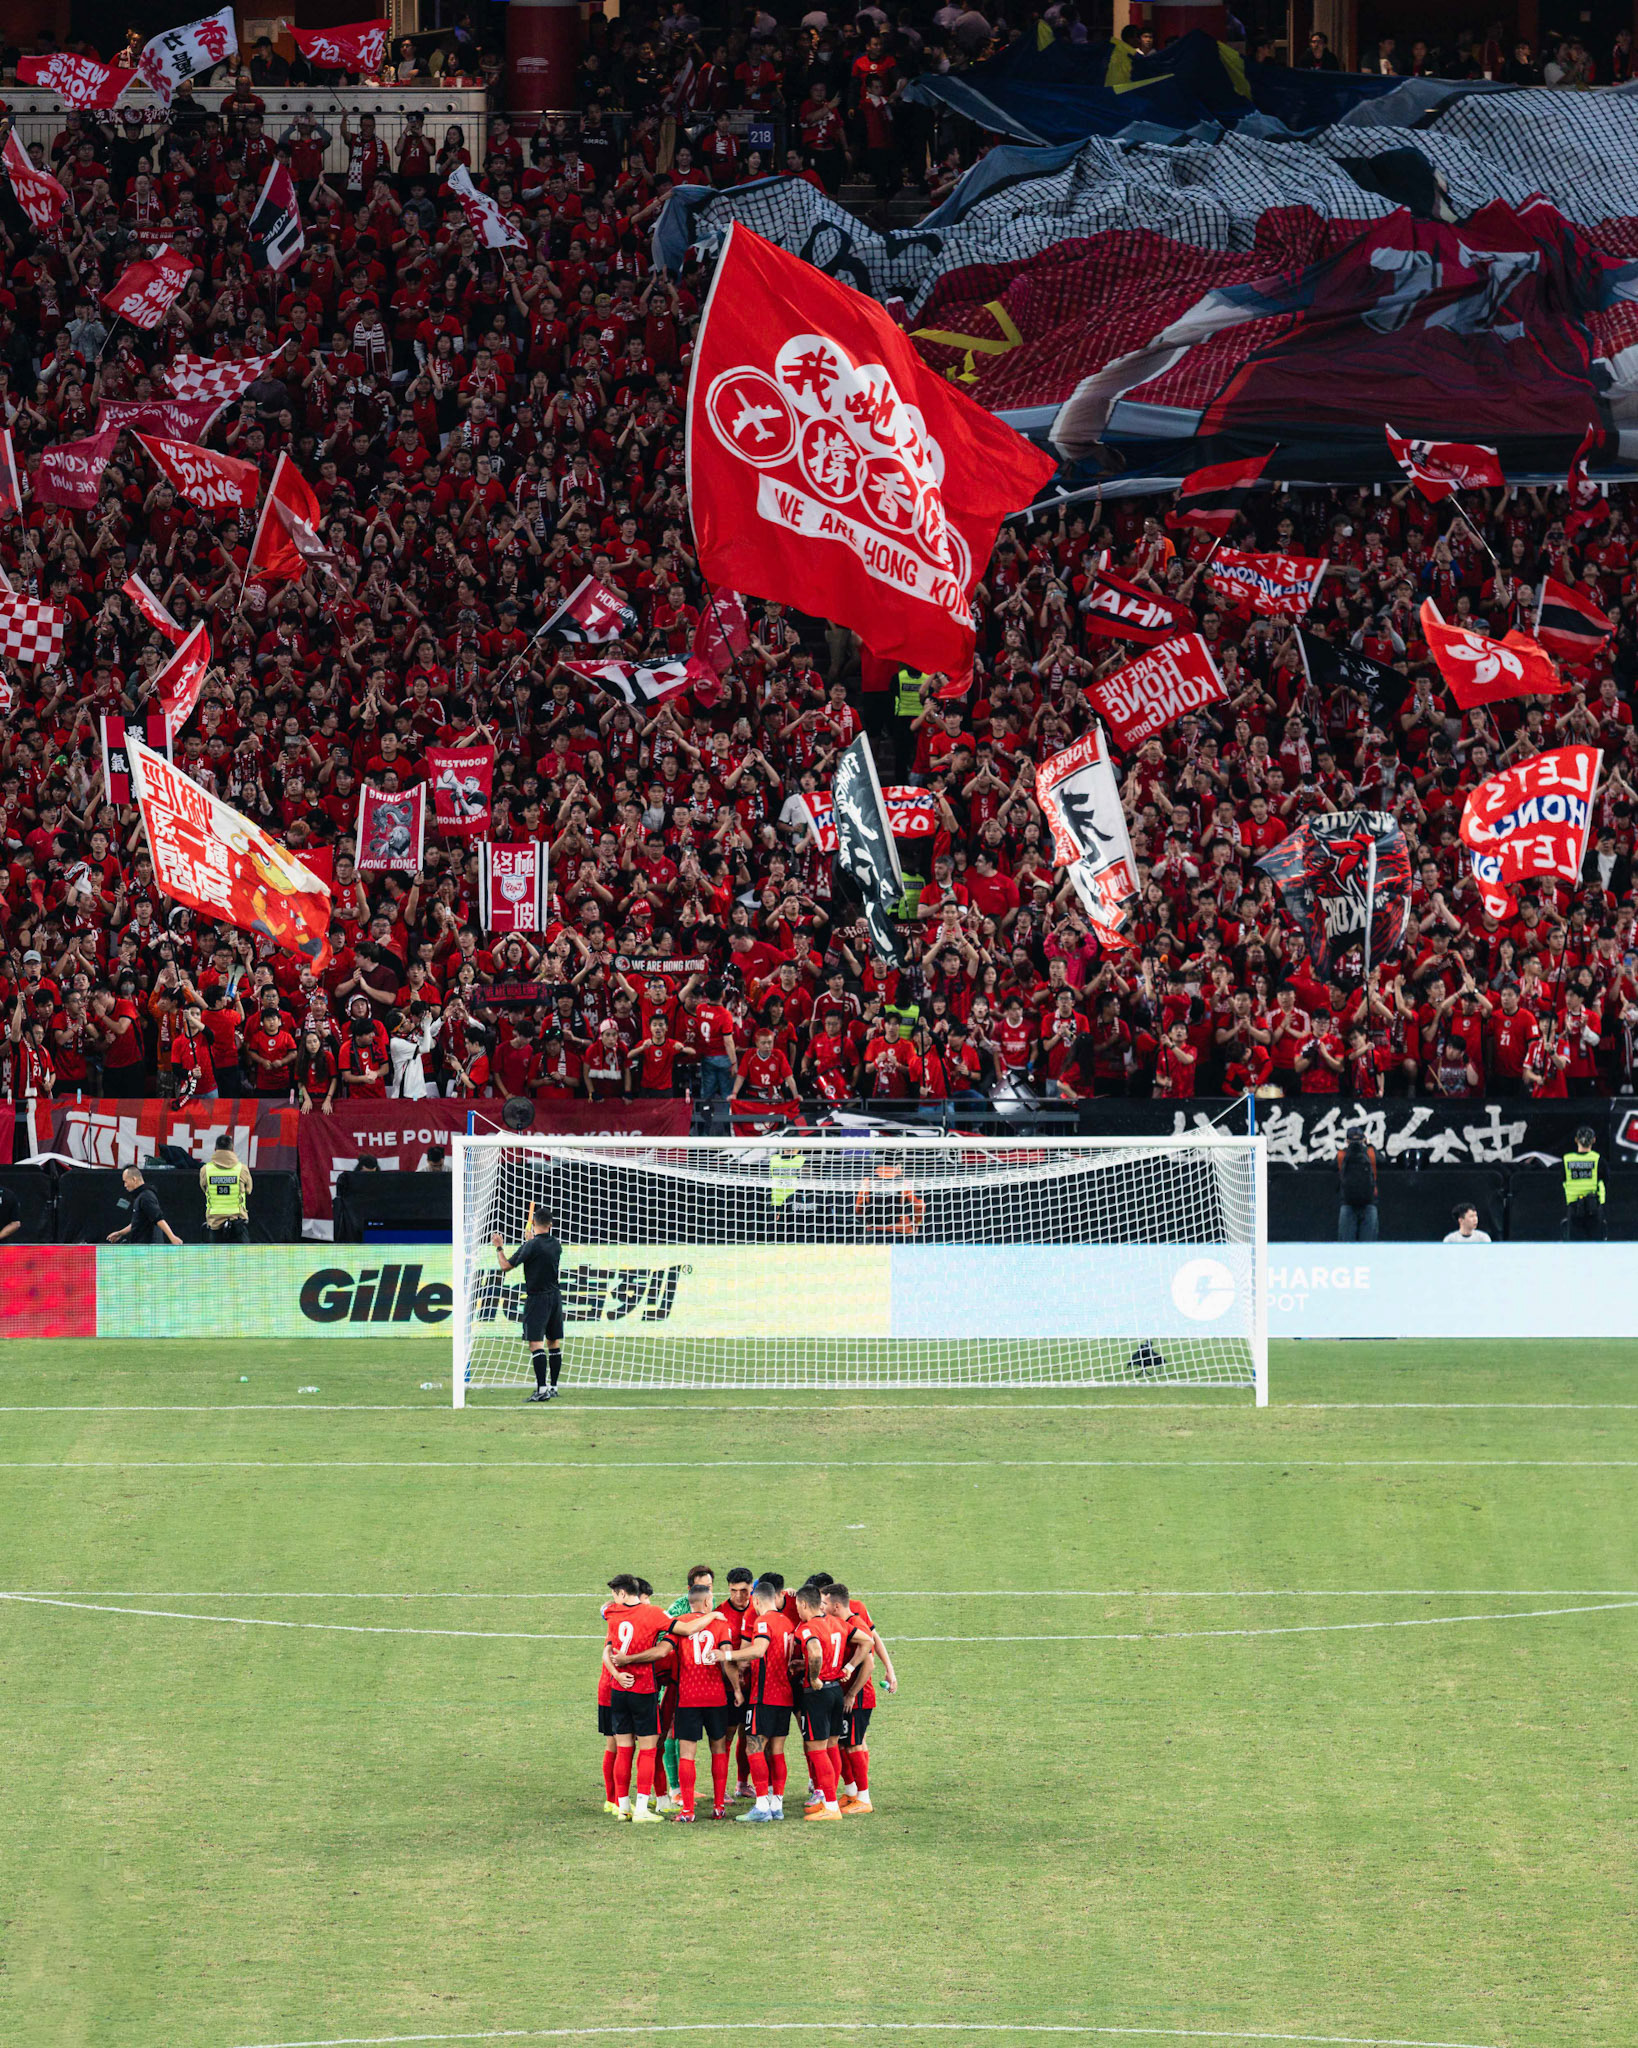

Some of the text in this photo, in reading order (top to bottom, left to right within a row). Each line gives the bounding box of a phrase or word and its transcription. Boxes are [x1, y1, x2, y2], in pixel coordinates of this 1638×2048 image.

[750, 131, 772, 143] 218
[412, 147, 424, 157] 21
[775, 488, 805, 527] WE
[111, 753, 129, 773] 氣
[434, 757, 488, 768] WESTWOOD
[369, 788, 401, 802] BRING
[437, 810, 489, 825] HONG KONG
[889, 811, 930, 833] GO
[360, 858, 416, 870] HONG KONG
[493, 850, 534, 878] 終極
[156, 842, 237, 922] 態度
[493, 902, 534, 930] 一坡
[632, 959, 705, 972] WE ARE HONG KONG
[1500, 1034, 1510, 1046] 21
[761, 1074, 771, 1084] 12
[353, 1131, 397, 1147] THE
[218, 1186, 229, 1194] 36
[1268, 1266, 1370, 1289] HARGE
[1266, 1293, 1310, 1313] POT
[618, 1621, 634, 1655] 9
[688, 1630, 716, 1665] 12
[830, 1632, 841, 1667] 7
